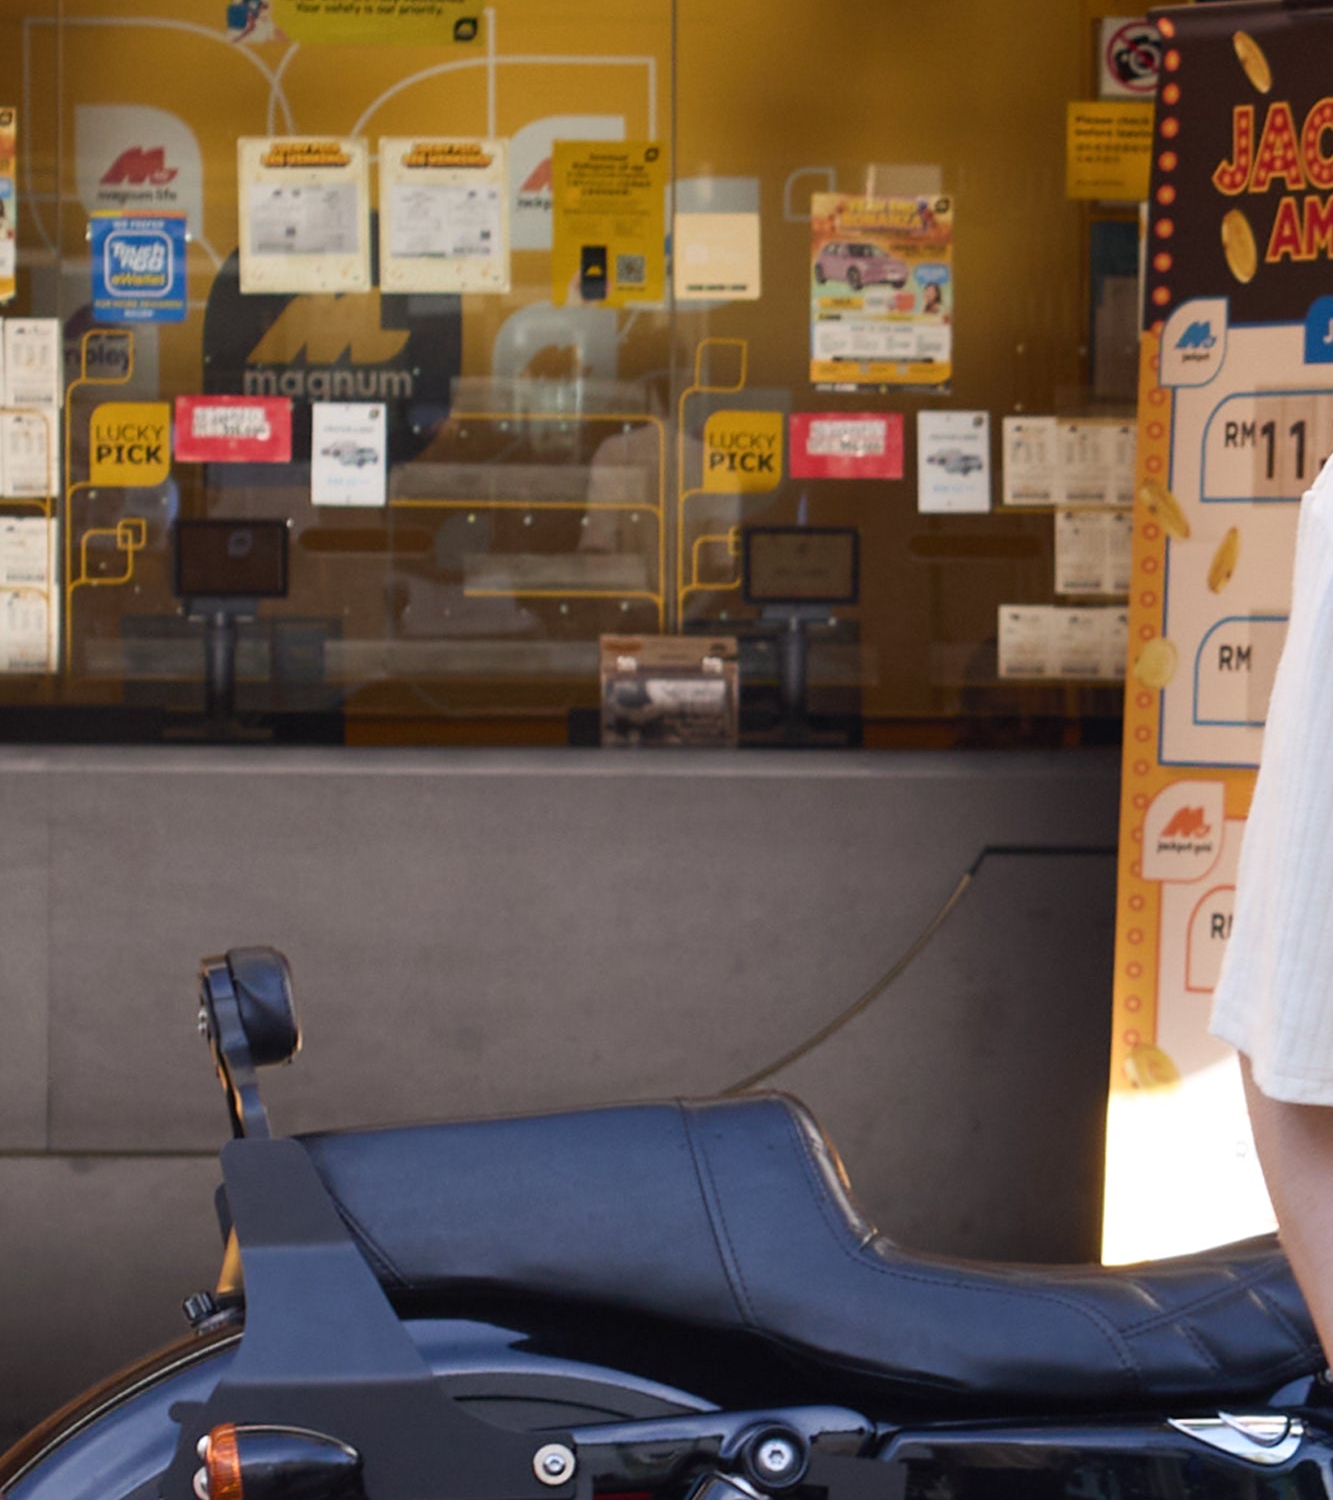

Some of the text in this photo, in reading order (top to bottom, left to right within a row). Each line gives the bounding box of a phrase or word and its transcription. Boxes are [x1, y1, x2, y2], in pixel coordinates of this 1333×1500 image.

[243, 369, 414, 403] magnum
[95, 423, 164, 442] LUCKY
[708, 432, 777, 450] LUCKY
[1223, 420, 1256, 448] RM
[96, 444, 163, 465] PICK
[709, 452, 775, 473] PICK
[1217, 645, 1252, 672] RM
[1210, 913, 1234, 940] R
